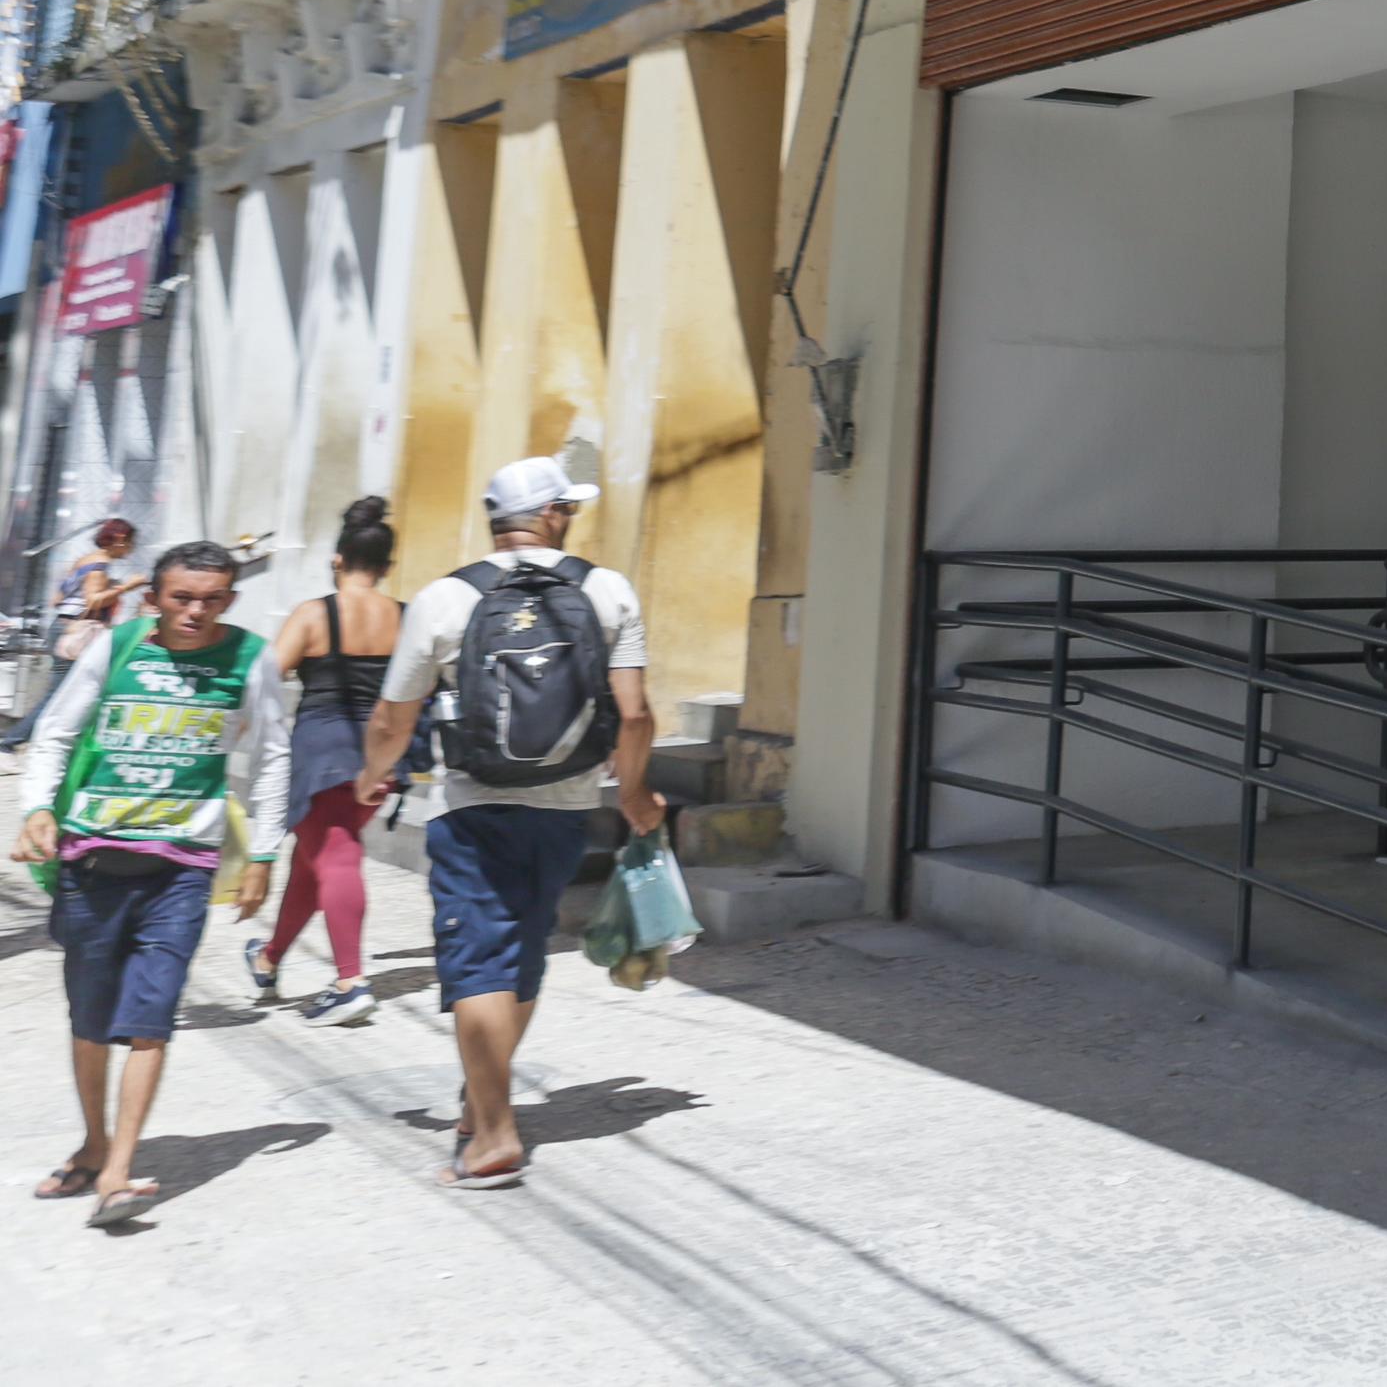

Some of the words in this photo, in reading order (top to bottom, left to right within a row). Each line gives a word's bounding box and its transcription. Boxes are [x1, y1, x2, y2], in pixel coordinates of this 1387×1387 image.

[127, 661, 218, 676] GRUPO
[124, 704, 224, 736] RIFA
[105, 754, 196, 767] GRUPO
